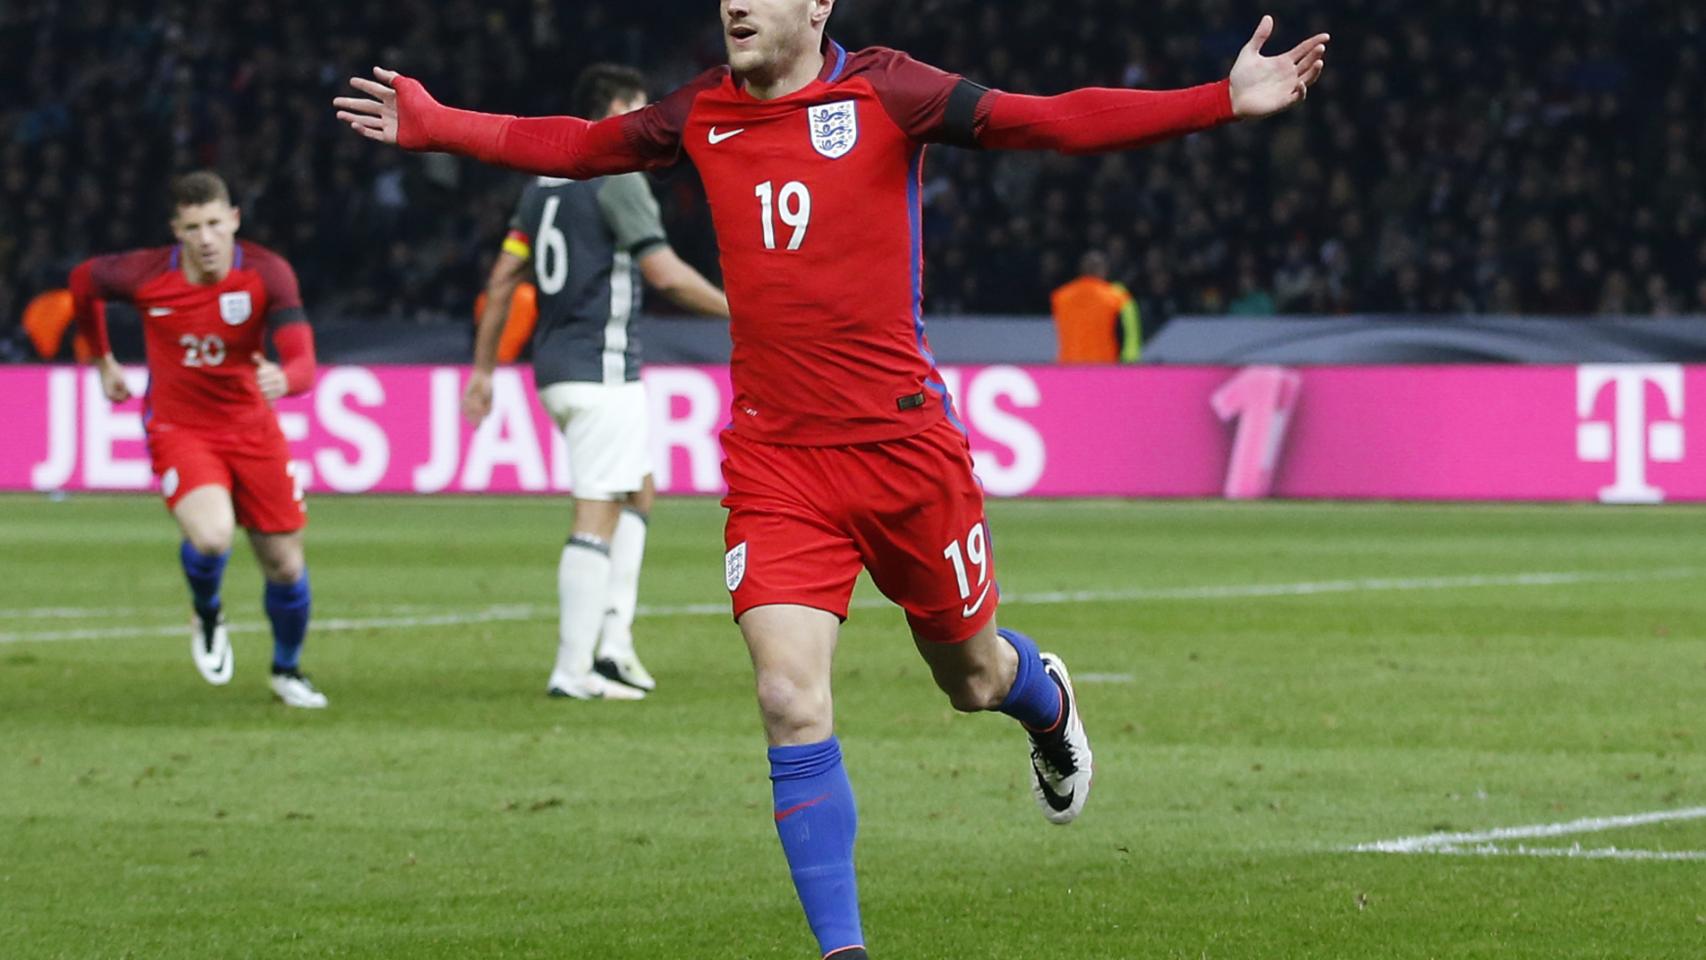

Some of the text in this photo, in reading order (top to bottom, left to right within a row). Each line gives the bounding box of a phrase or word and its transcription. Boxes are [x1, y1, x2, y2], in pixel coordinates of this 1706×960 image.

[535, 195, 569, 295] 6
[755, 180, 811, 251] 19
[179, 334, 226, 367] 20
[31, 366, 390, 493] JES
[412, 366, 723, 494] JAR
[943, 522, 988, 600] 19
